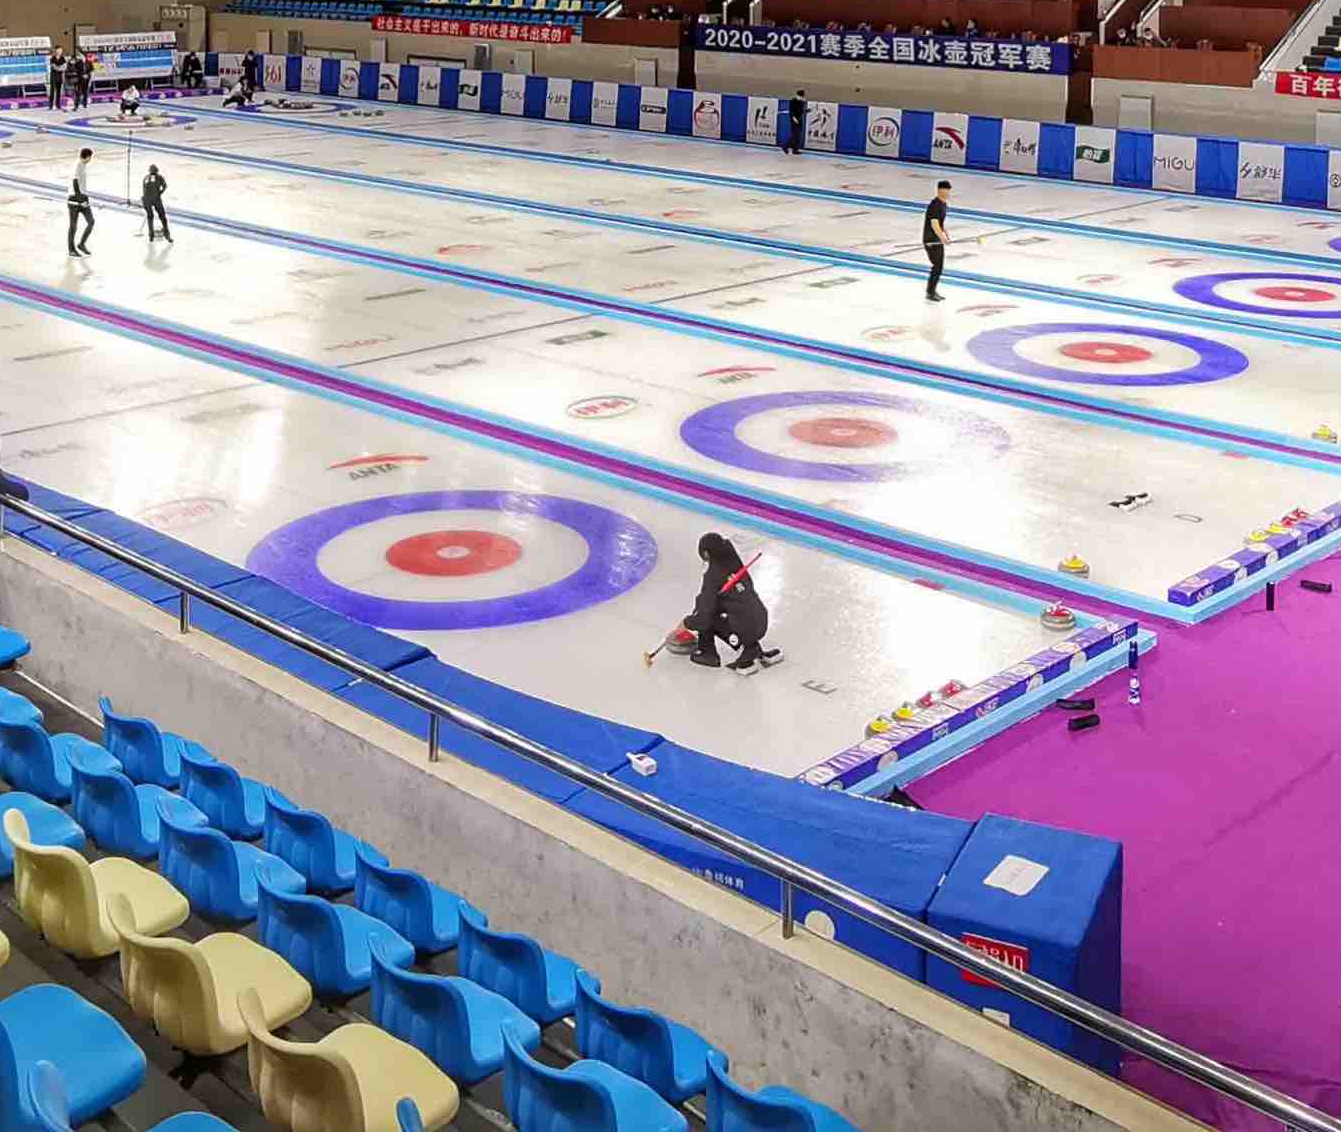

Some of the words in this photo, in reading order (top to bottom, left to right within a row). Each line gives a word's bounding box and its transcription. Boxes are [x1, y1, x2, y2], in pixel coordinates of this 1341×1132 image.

[704, 28, 1051, 71] 2020-2021赛季全国冰壶冠军赛
[1153, 155, 1194, 171] MIGU
